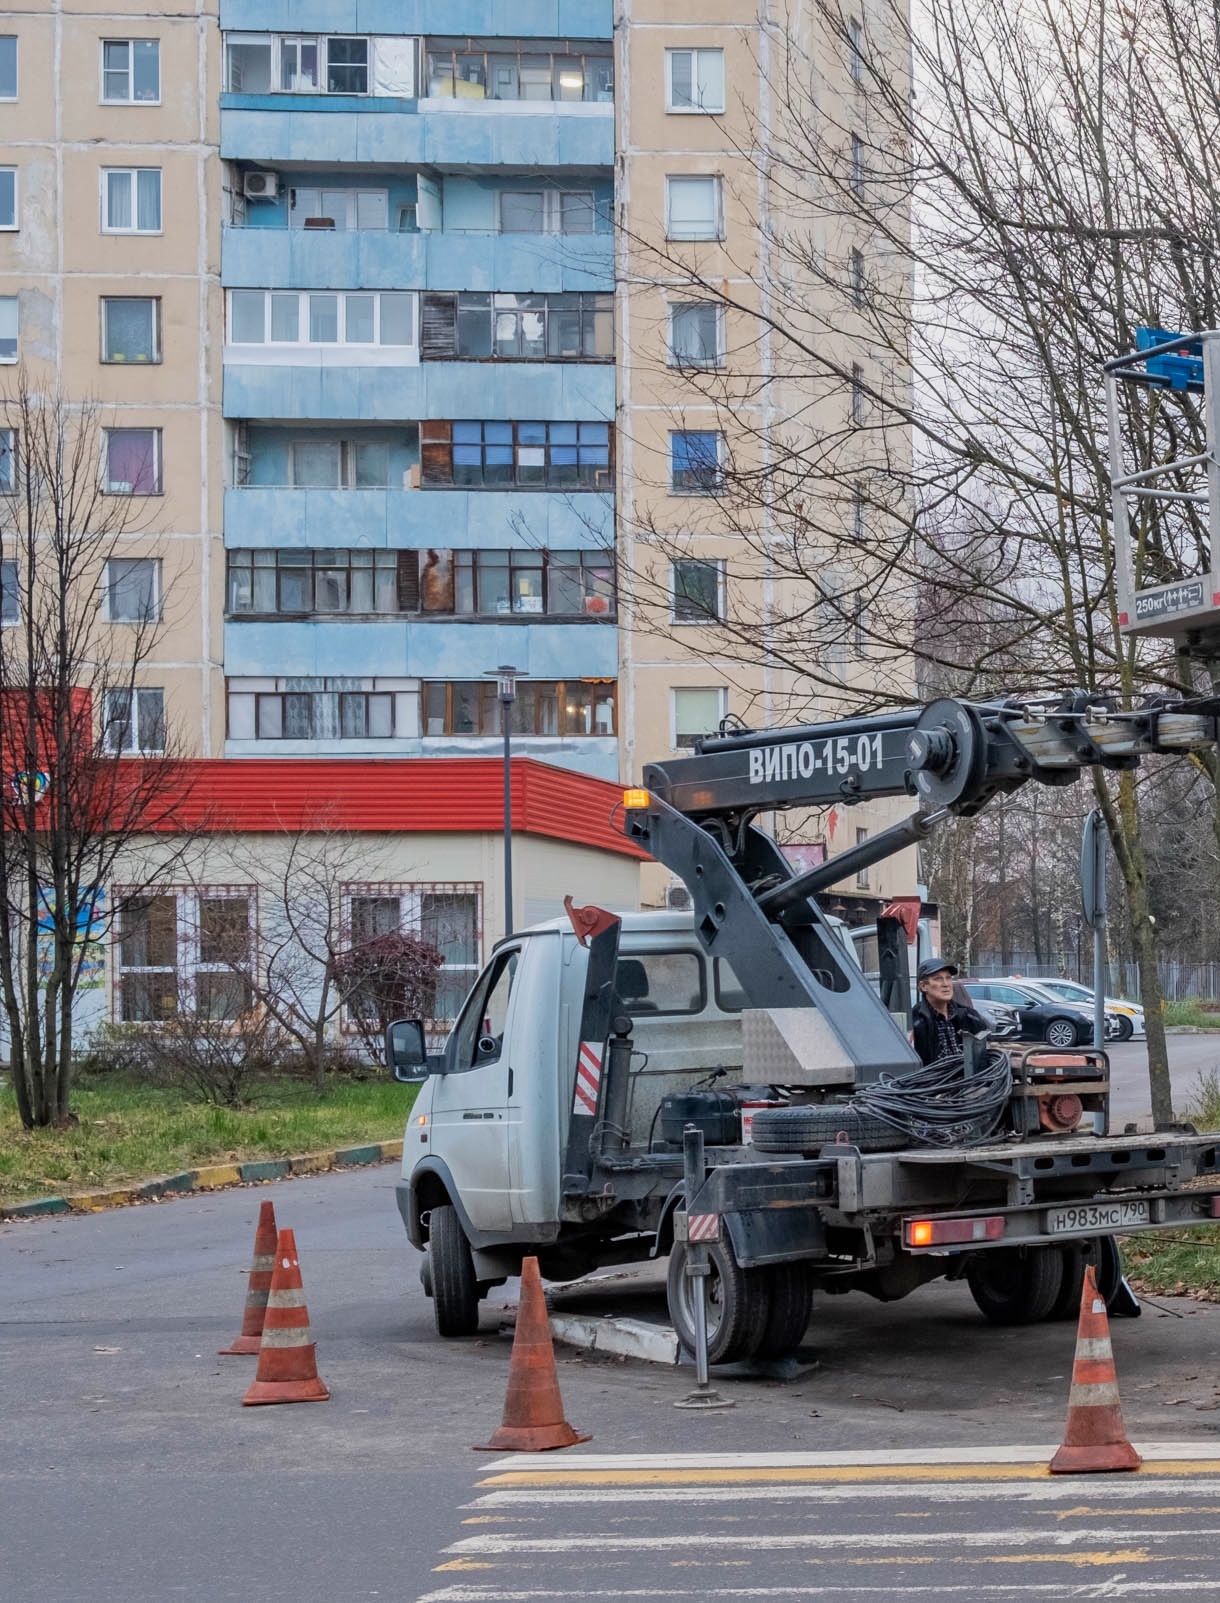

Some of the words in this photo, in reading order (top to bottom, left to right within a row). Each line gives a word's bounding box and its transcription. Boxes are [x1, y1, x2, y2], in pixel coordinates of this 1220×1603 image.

[749, 733, 883, 784] ВИПО-15-01
[1056, 1207, 1120, 1230] Н983МС
[1121, 1202, 1146, 1218] 790
